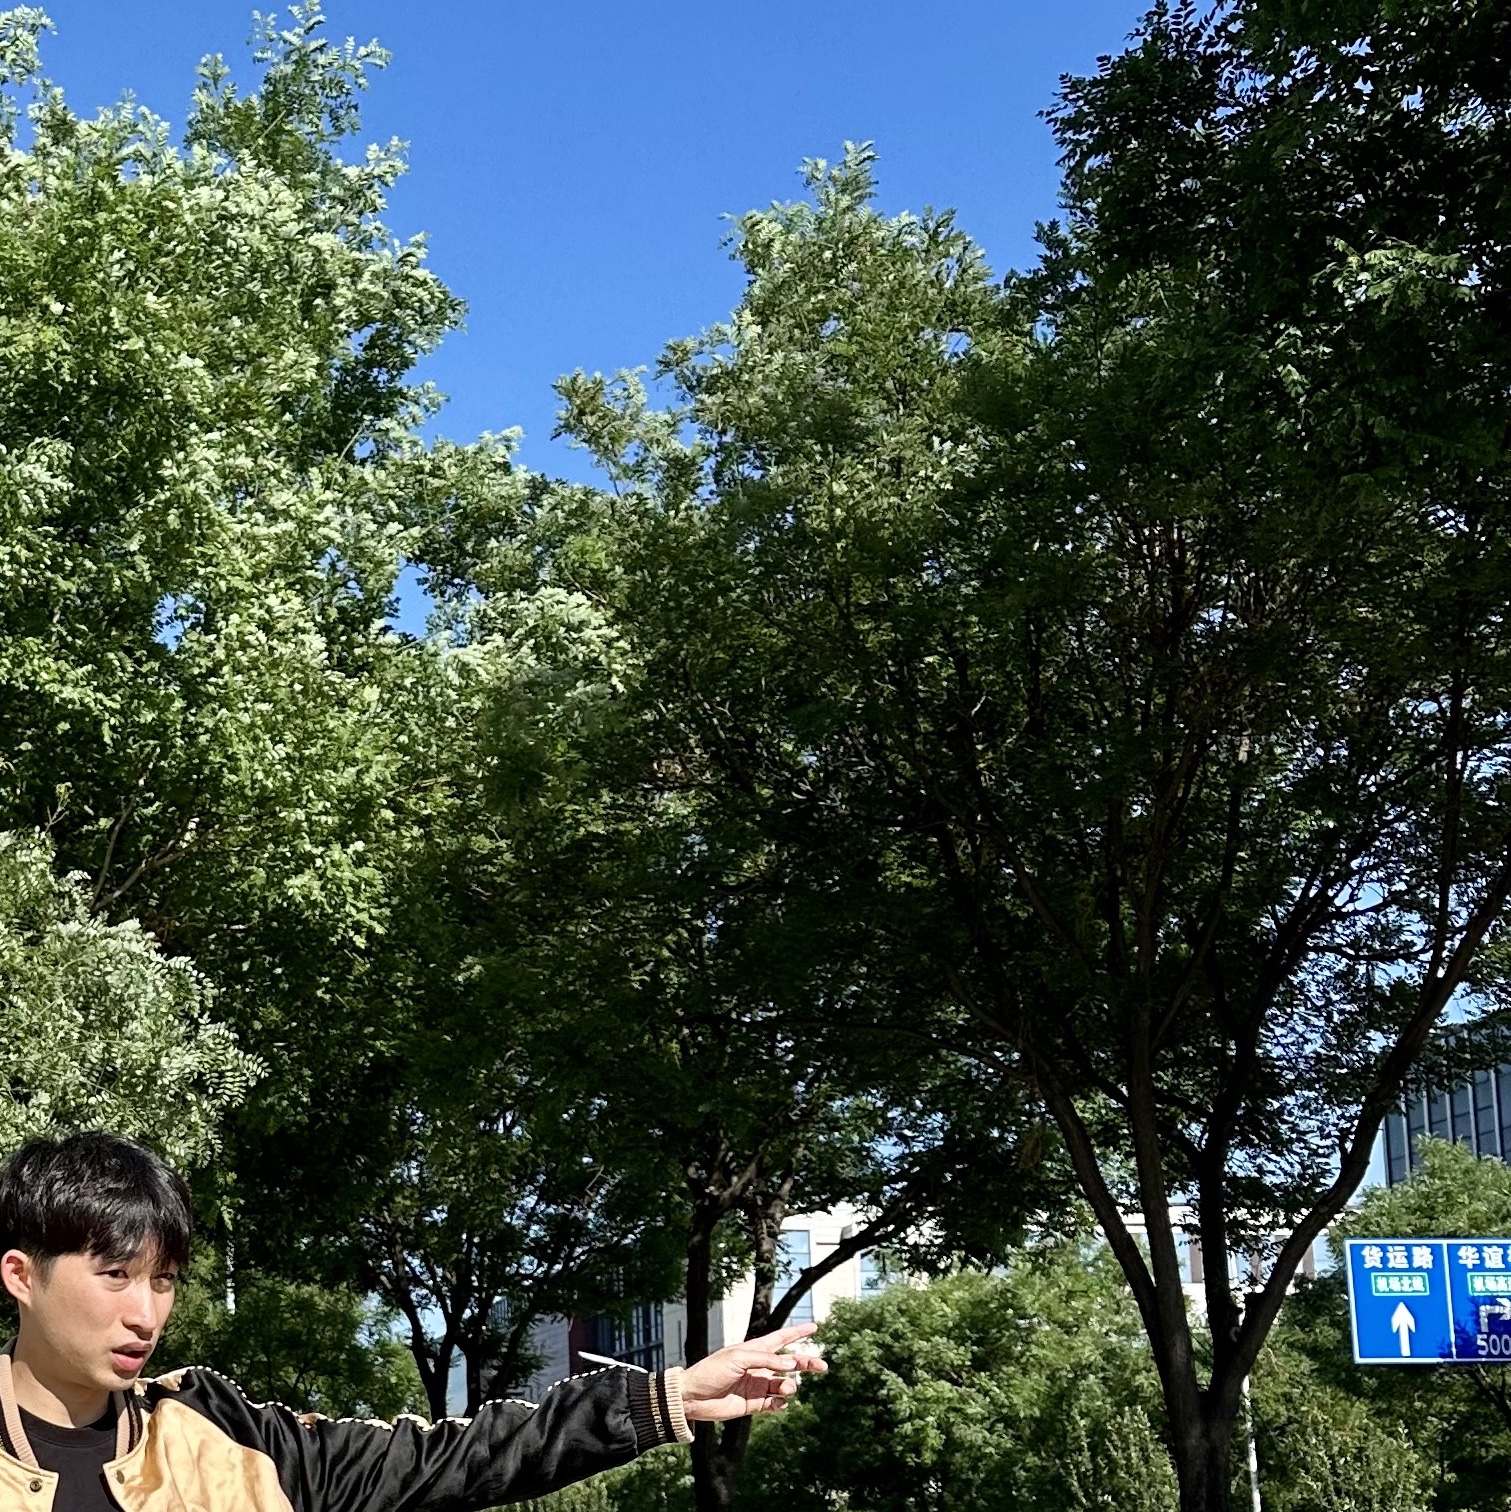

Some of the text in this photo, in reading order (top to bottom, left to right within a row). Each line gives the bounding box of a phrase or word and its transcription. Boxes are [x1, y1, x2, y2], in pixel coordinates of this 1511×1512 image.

[1361, 1245, 1433, 1269] 货运路
[1457, 1246, 1511, 1269] 华谊
[1477, 1335, 1511, 1356] 500
